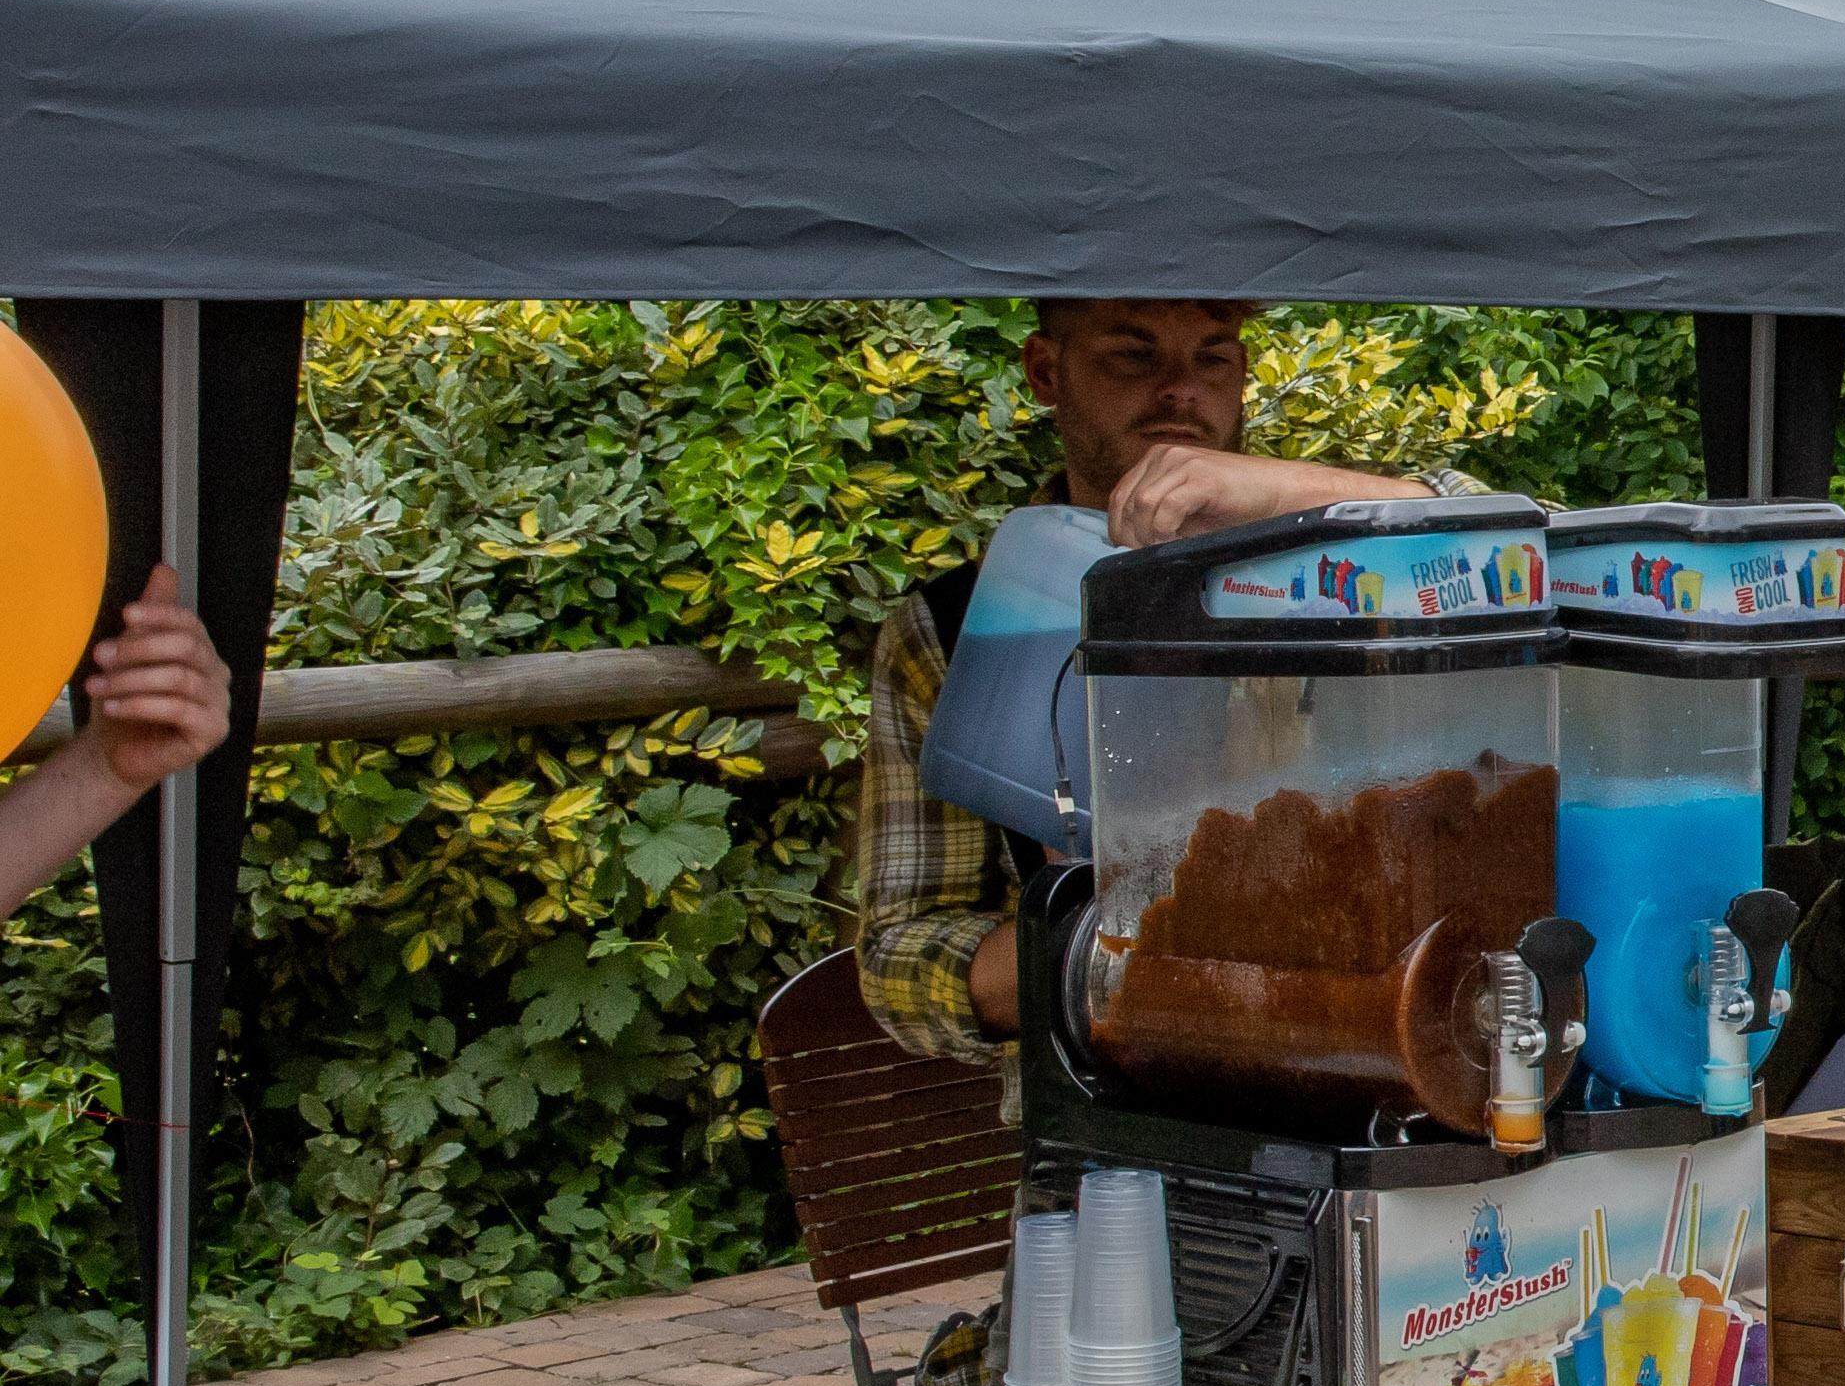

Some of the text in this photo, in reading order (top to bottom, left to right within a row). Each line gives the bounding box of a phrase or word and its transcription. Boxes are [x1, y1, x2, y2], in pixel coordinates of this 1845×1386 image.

[1411, 555, 1457, 588] FRESH
[1730, 556, 1773, 587] FRESH
[1418, 587, 1440, 616] AND
[1438, 576, 1477, 611] COOL
[1735, 586, 1756, 614] AND
[1755, 577, 1791, 611] COOL
[1403, 1265, 1567, 1344] MonsterSlush
